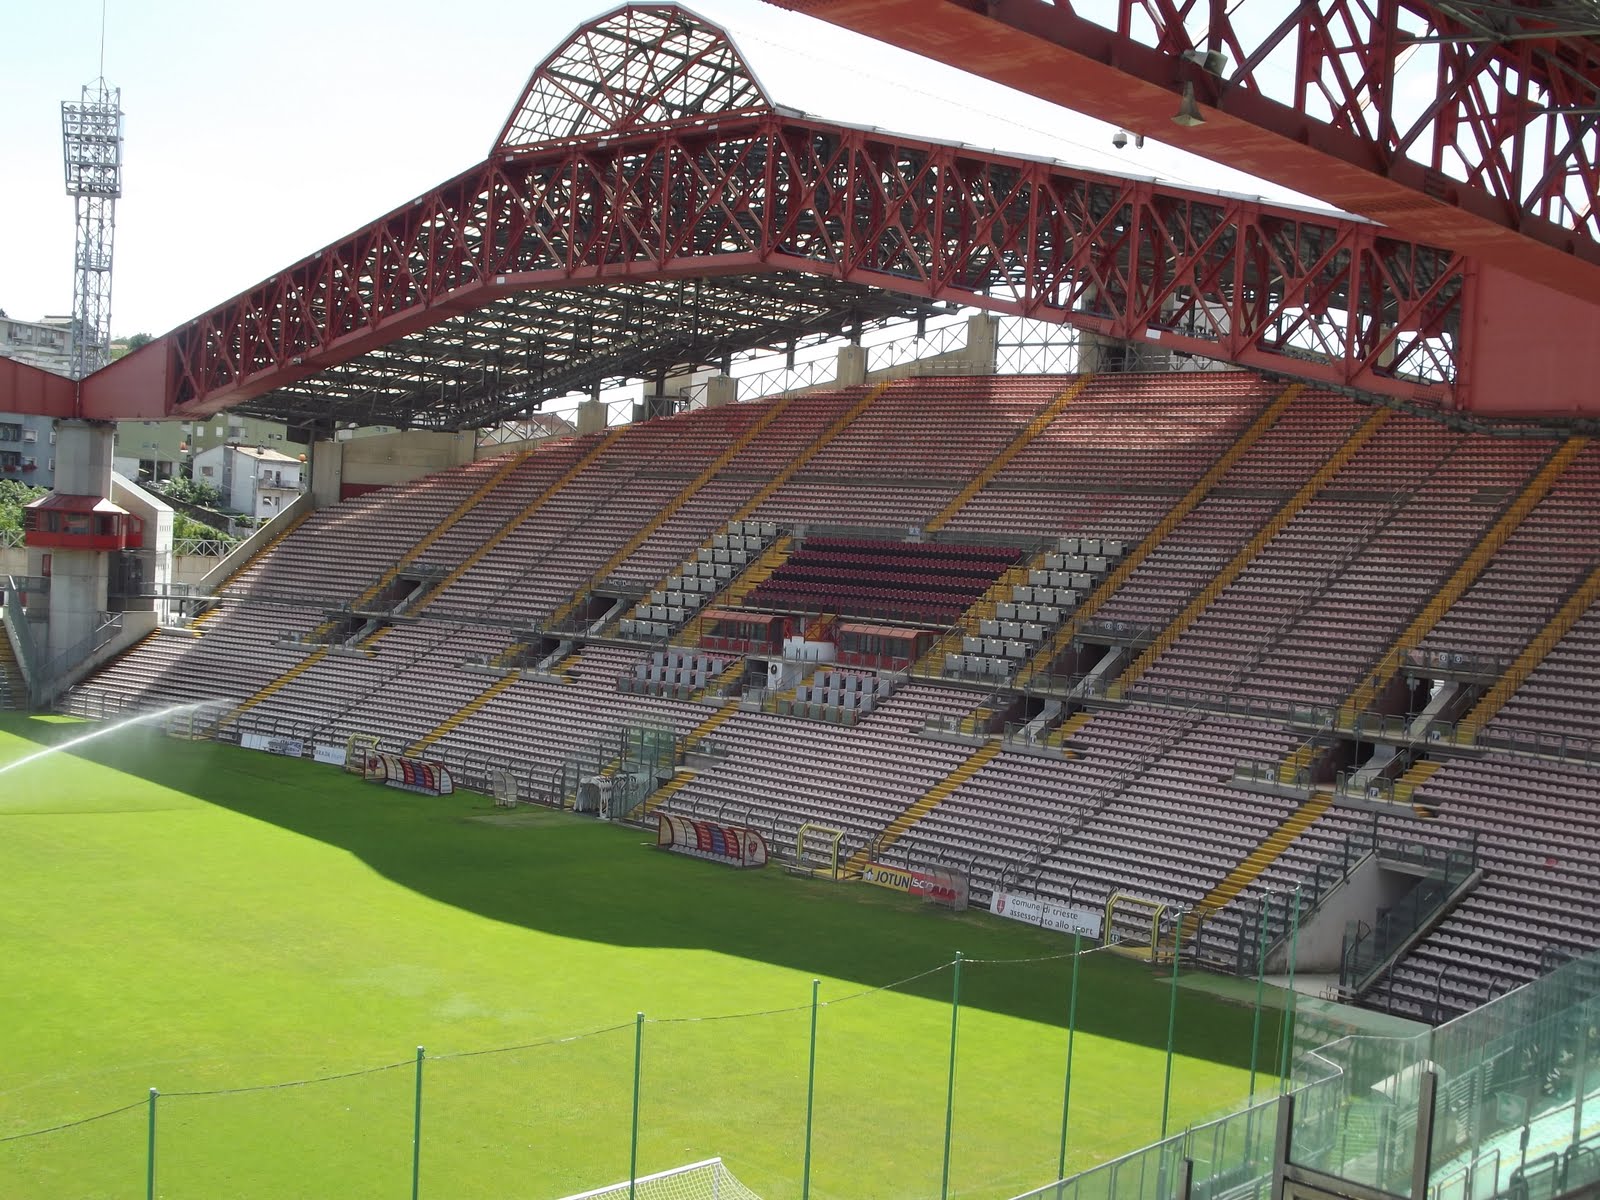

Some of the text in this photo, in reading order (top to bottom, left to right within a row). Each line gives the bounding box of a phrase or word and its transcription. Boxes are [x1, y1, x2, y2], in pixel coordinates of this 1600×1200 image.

[875, 871, 910, 889] JOTUN
[1011, 899, 1079, 920] comune di trieste
[1055, 921, 1070, 930] allo
